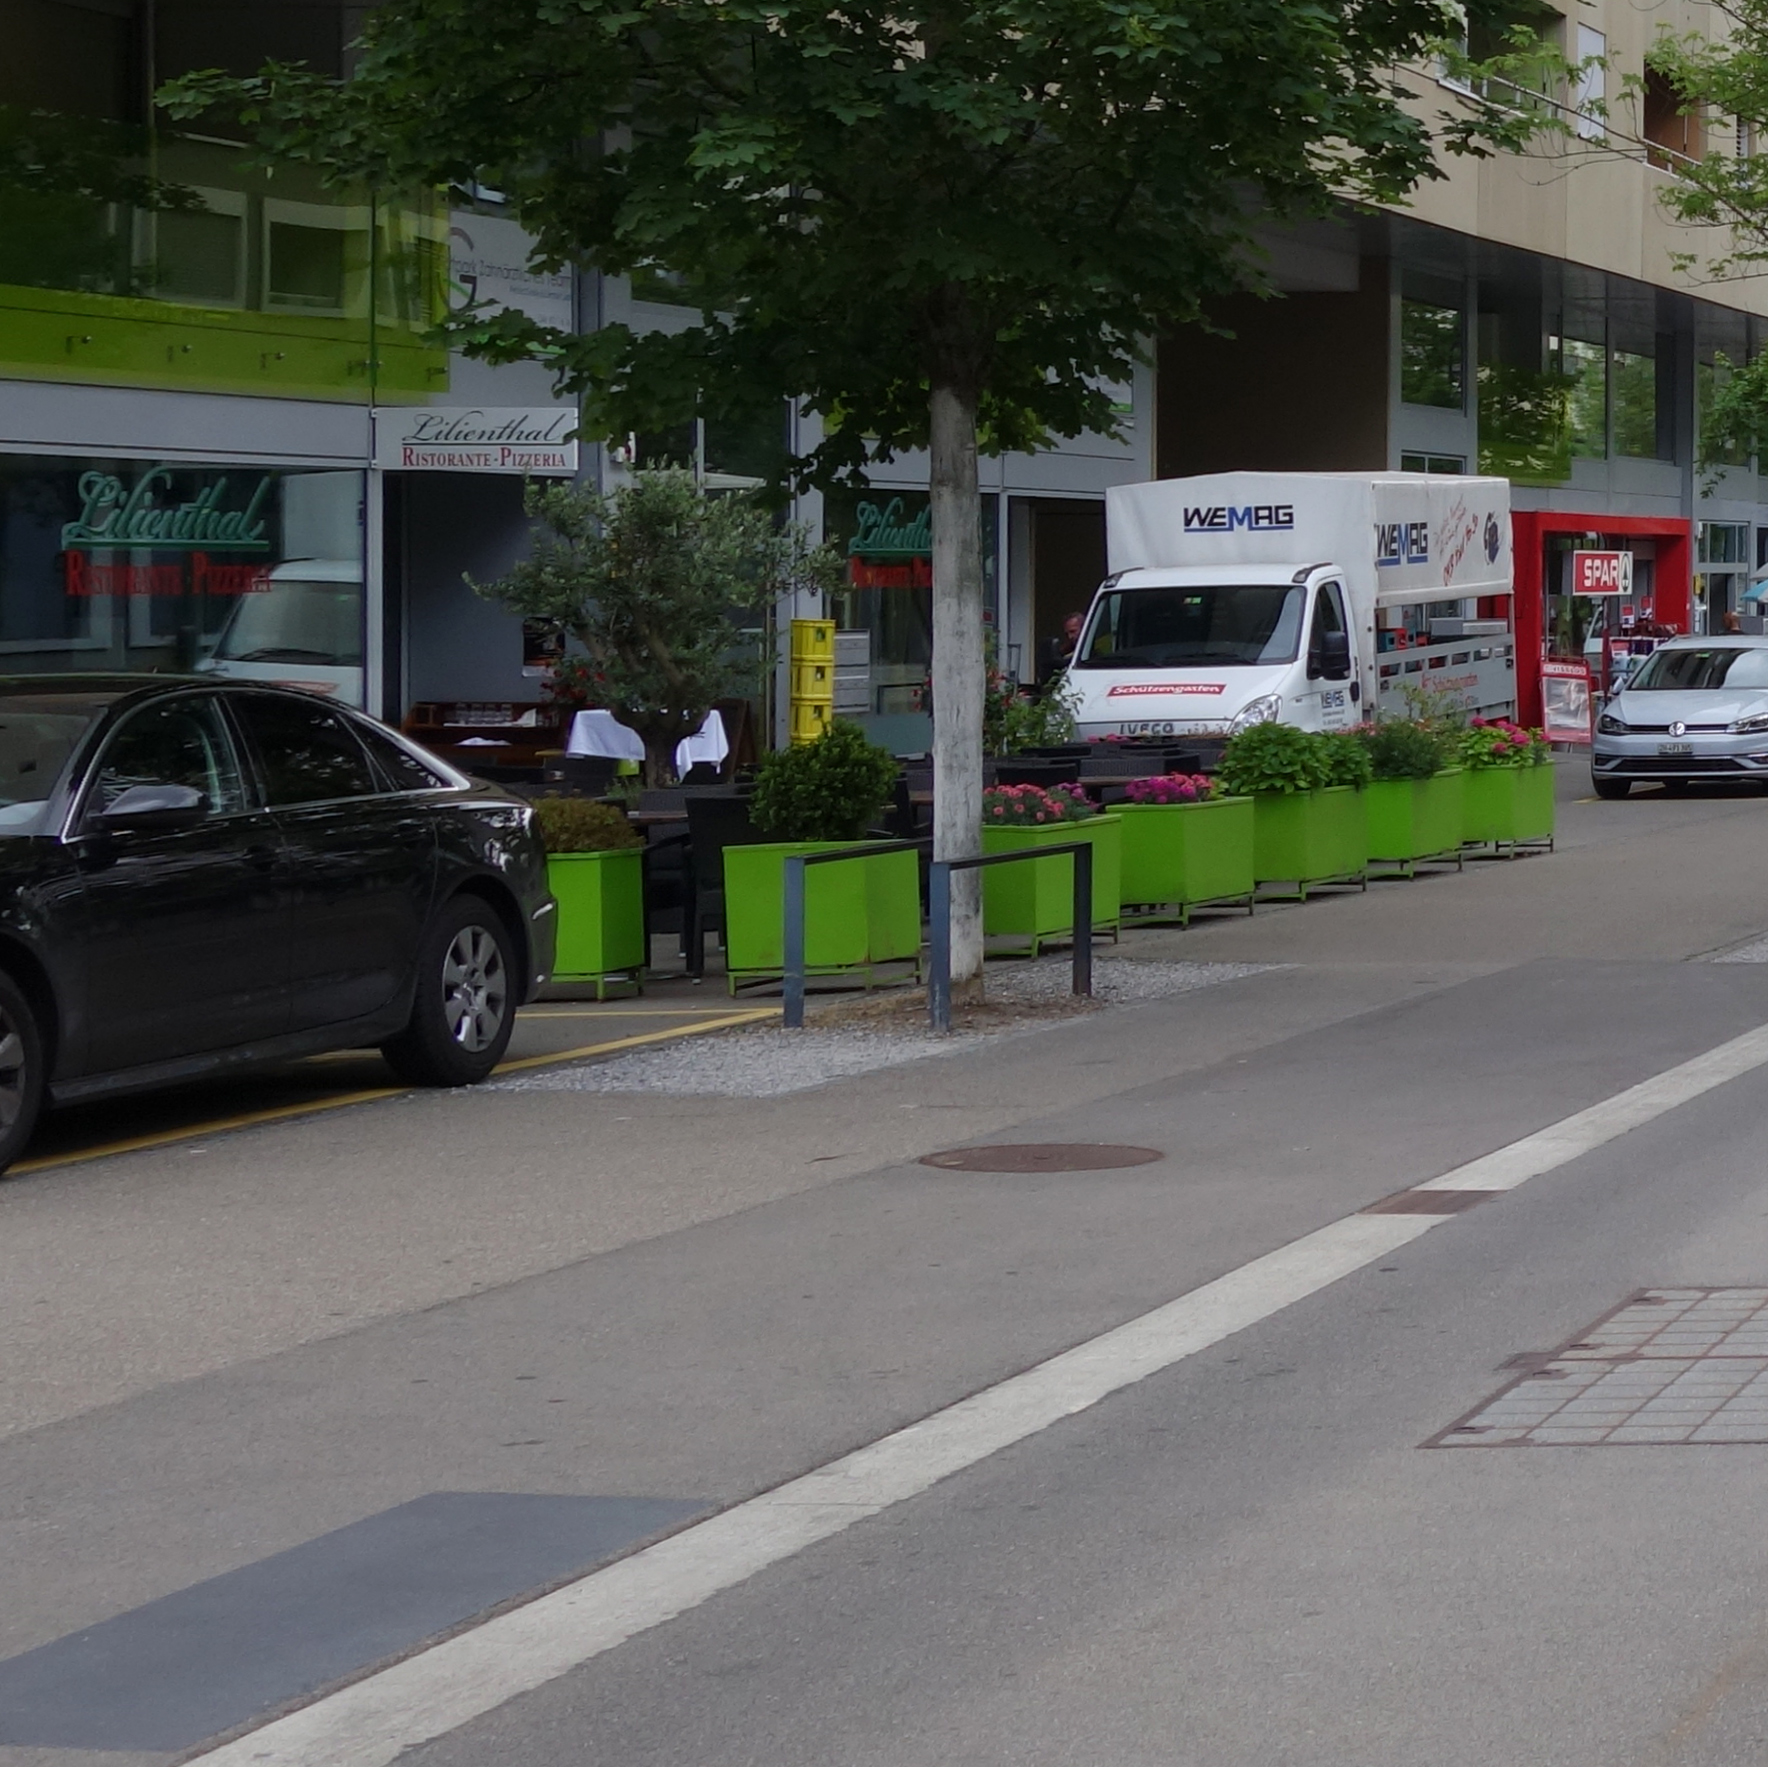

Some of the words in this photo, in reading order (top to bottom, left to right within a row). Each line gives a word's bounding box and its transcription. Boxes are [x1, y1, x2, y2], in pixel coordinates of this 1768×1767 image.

[402, 410, 566, 441] Lilienthal
[61, 465, 274, 541] Lilienthal
[1184, 504, 1294, 530] WEMAG
[848, 496, 932, 550] Lilienth
[1376, 521, 1428, 558] WEMAG
[1583, 558, 1619, 587] SPAR
[1113, 684, 1220, 695] Schützengarten
[1119, 722, 1175, 735] IVECO
